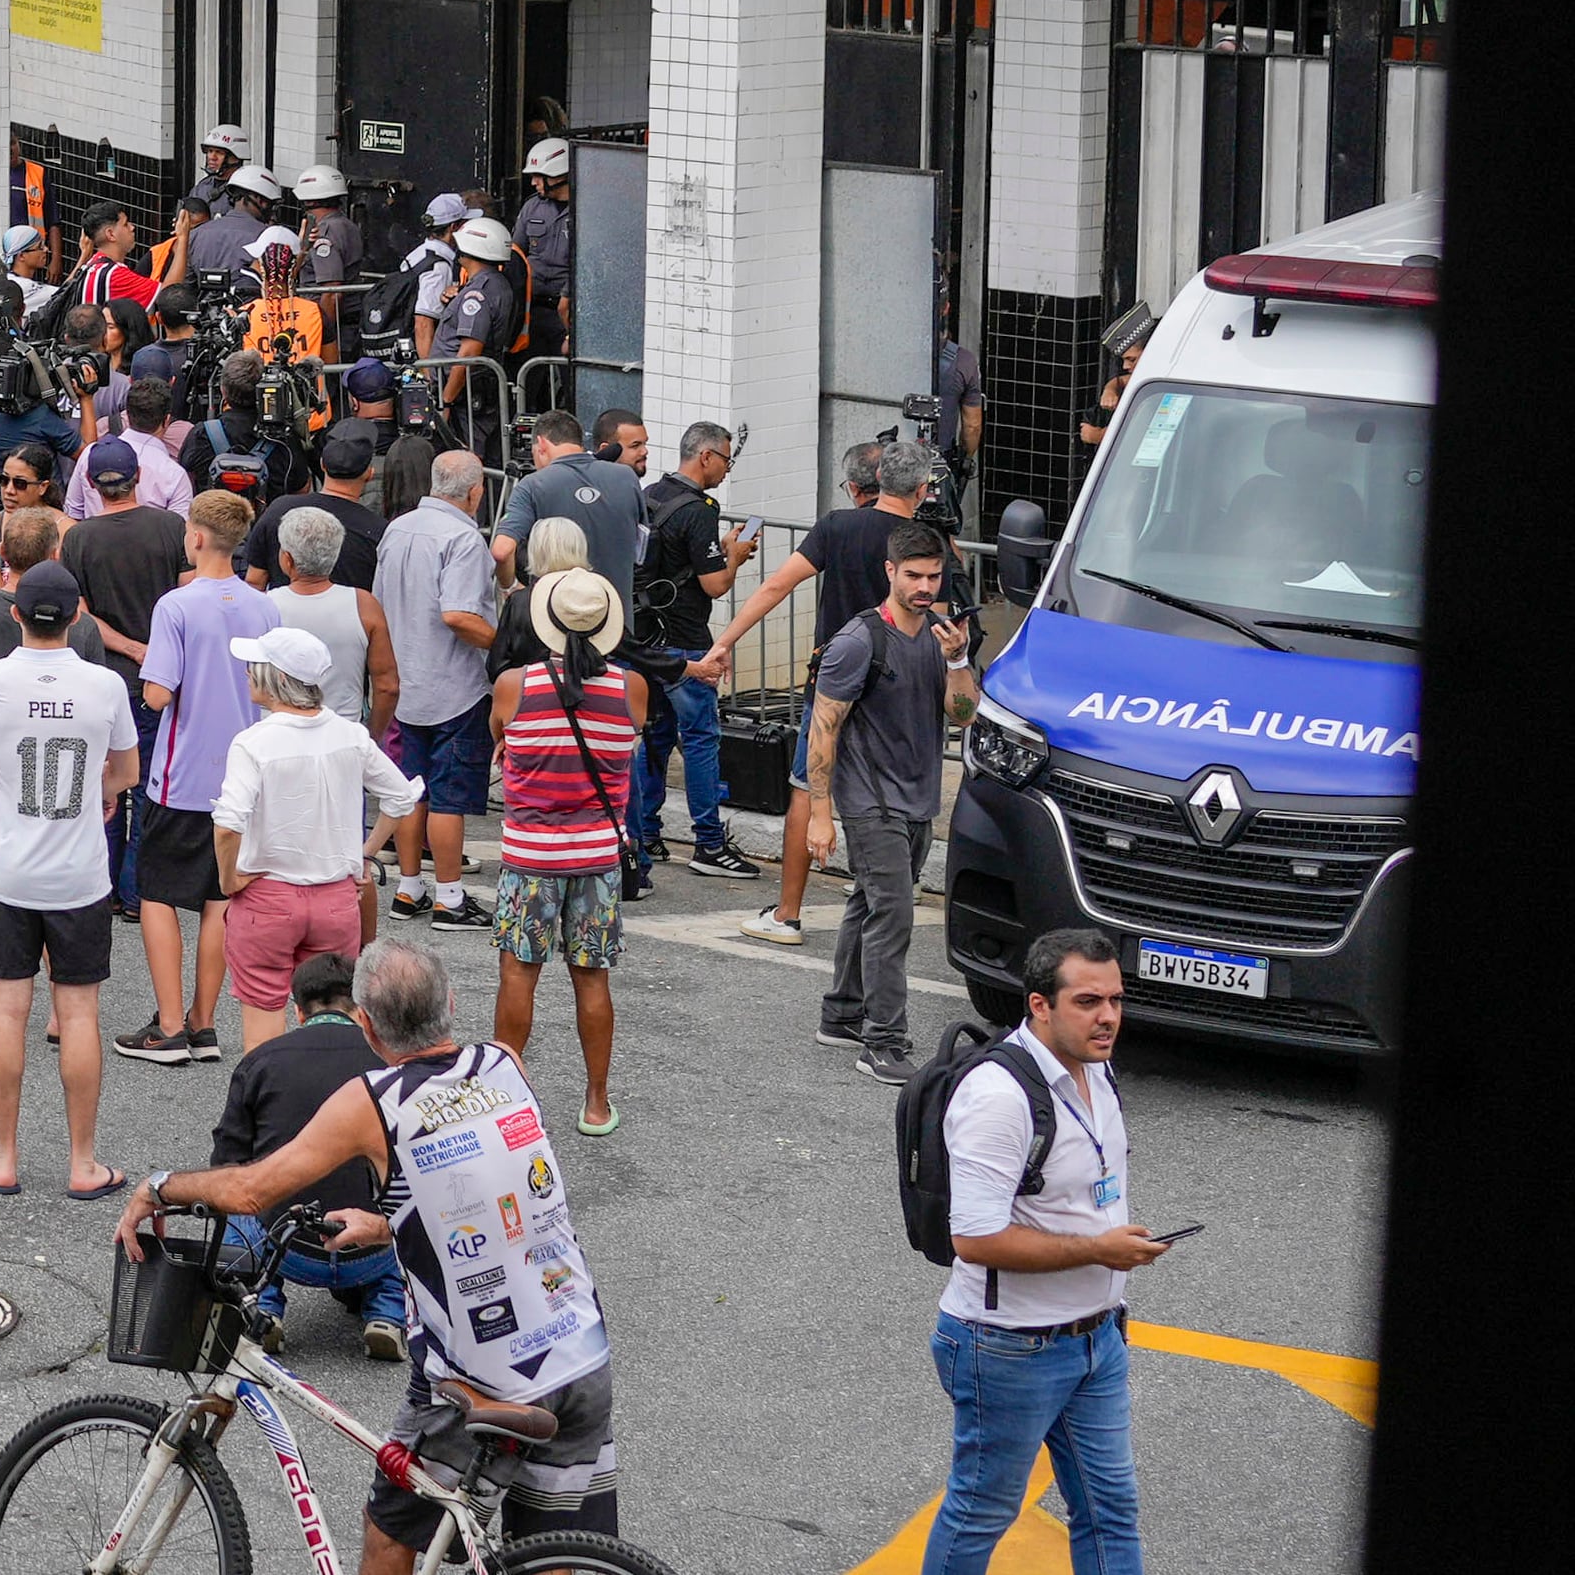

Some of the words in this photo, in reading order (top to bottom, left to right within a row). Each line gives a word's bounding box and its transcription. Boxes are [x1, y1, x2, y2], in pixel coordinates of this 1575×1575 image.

[260, 310, 301, 323] STAFF
[28, 698, 74, 720] PELÉ
[16, 736, 88, 821] 10
[1149, 954, 1251, 991] BWY5B34
[415, 1075, 485, 1115] PRAÇA
[421, 1086, 513, 1133] MALDITA
[410, 1142, 436, 1158] BOM
[436, 1130, 477, 1151] RETIRO
[414, 1139, 483, 1169] ELETRICIDADE
[446, 1233, 487, 1260] KLP
[505, 1226, 524, 1241] BIG
[240, 1389, 273, 1420] 29
